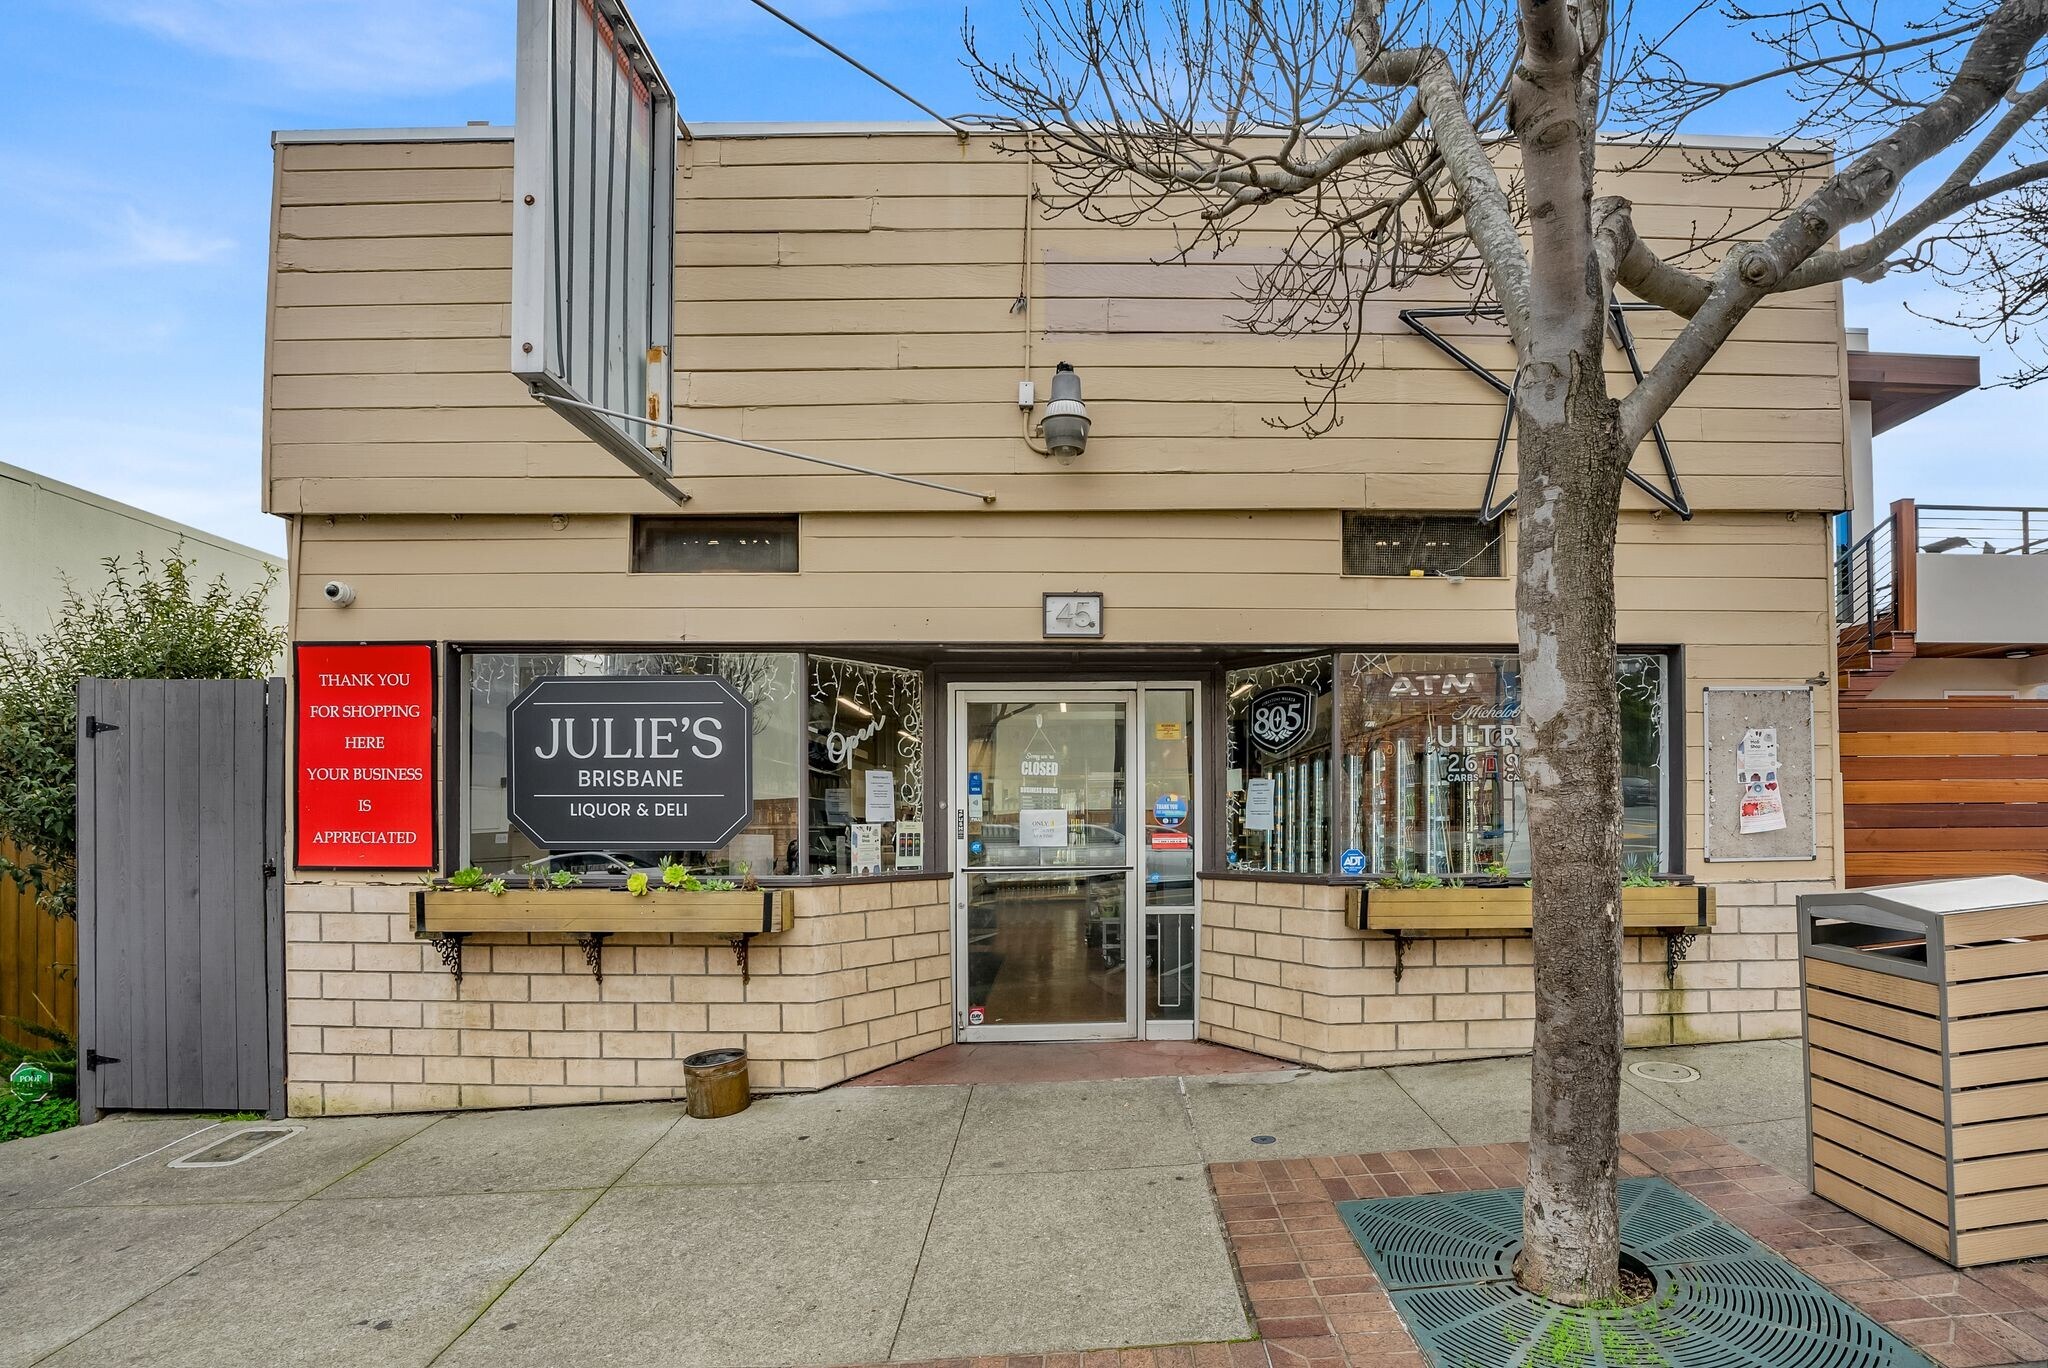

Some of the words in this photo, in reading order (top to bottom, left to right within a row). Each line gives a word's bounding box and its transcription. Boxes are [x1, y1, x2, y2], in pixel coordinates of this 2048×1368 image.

[1056, 602, 1091, 628] 45
[319, 673, 374, 687] THANK
[378, 673, 410, 687] YOU
[1389, 673, 1476, 696] ATM
[310, 706, 339, 718] FOR
[343, 705, 421, 718] SHOPPING
[1254, 703, 1302, 735] 805
[1452, 703, 1522, 720] Michelob
[344, 736, 385, 749] HERE
[535, 716, 723, 760] JULIE'S
[826, 715, 886, 770] Open
[1437, 725, 1519, 747] ULTR
[1021, 761, 1059, 776] CLOSED
[1448, 753, 1478, 772] 2.6
[307, 768, 350, 781] YOUR
[353, 767, 423, 781] BUSINESS
[579, 769, 684, 787] BRISBANE
[1447, 773, 1479, 782] CARBS
[1507, 774, 1521, 782] CA
[358, 799, 372, 812] IS
[571, 802, 631, 819] LIQUOR
[636, 802, 650, 817] &
[655, 802, 688, 817] DELI
[312, 831, 417, 844] APPRECIATED
[1343, 856, 1363, 866] ADT
